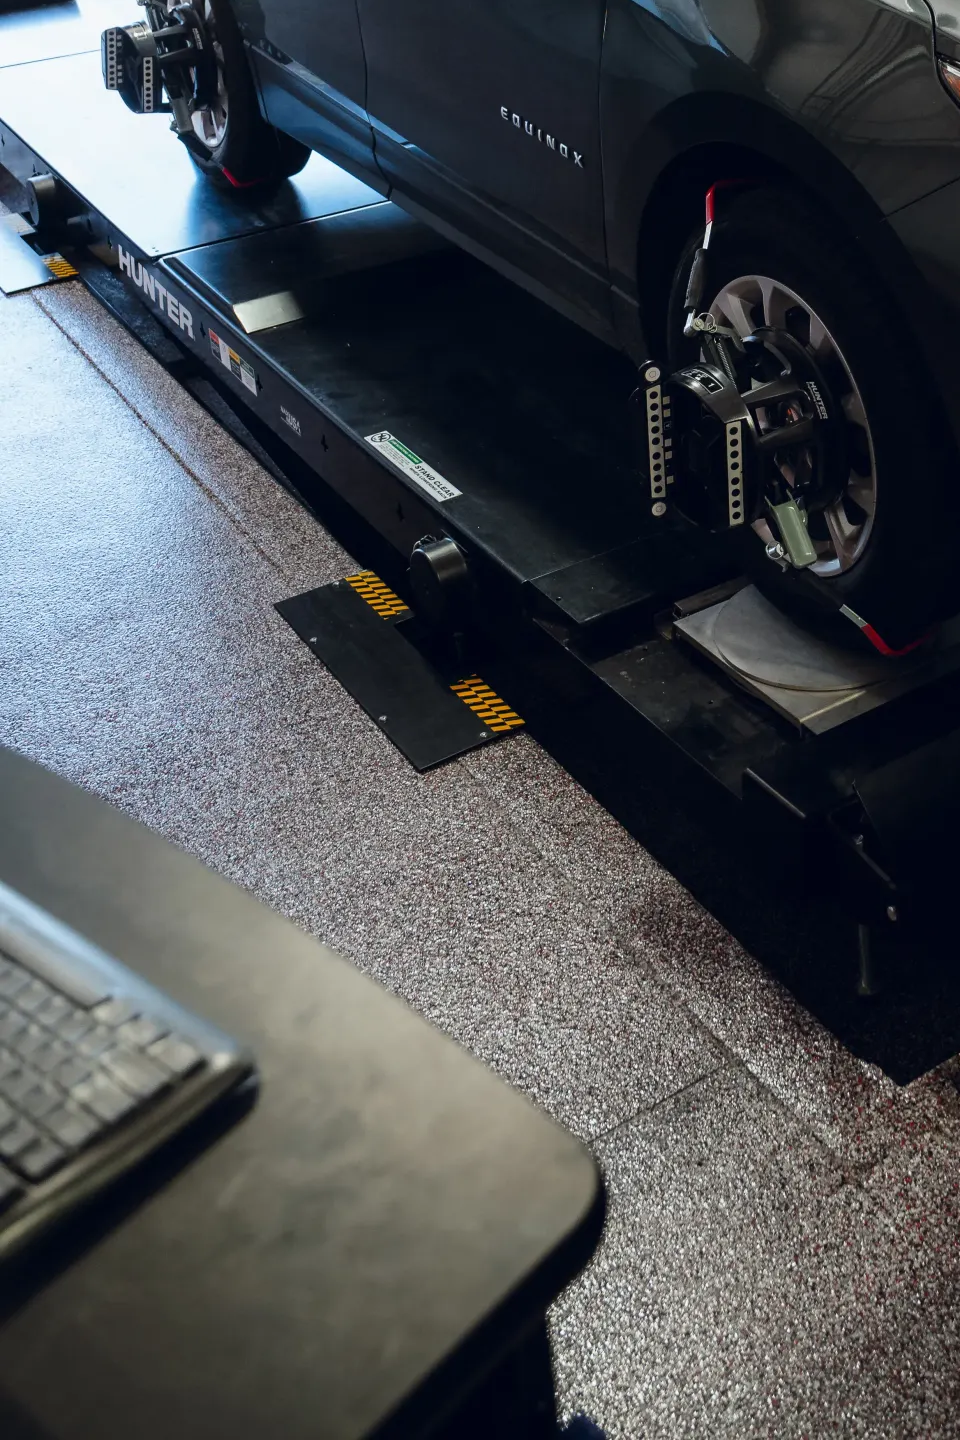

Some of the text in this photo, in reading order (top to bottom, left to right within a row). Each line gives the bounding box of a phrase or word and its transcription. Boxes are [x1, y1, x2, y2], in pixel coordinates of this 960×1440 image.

[501, 106, 583, 168] EQUINOX
[118, 244, 195, 339] HUNTER
[809, 381, 828, 419] HUNTER
[414, 464, 455, 497] STAND CLEAR
